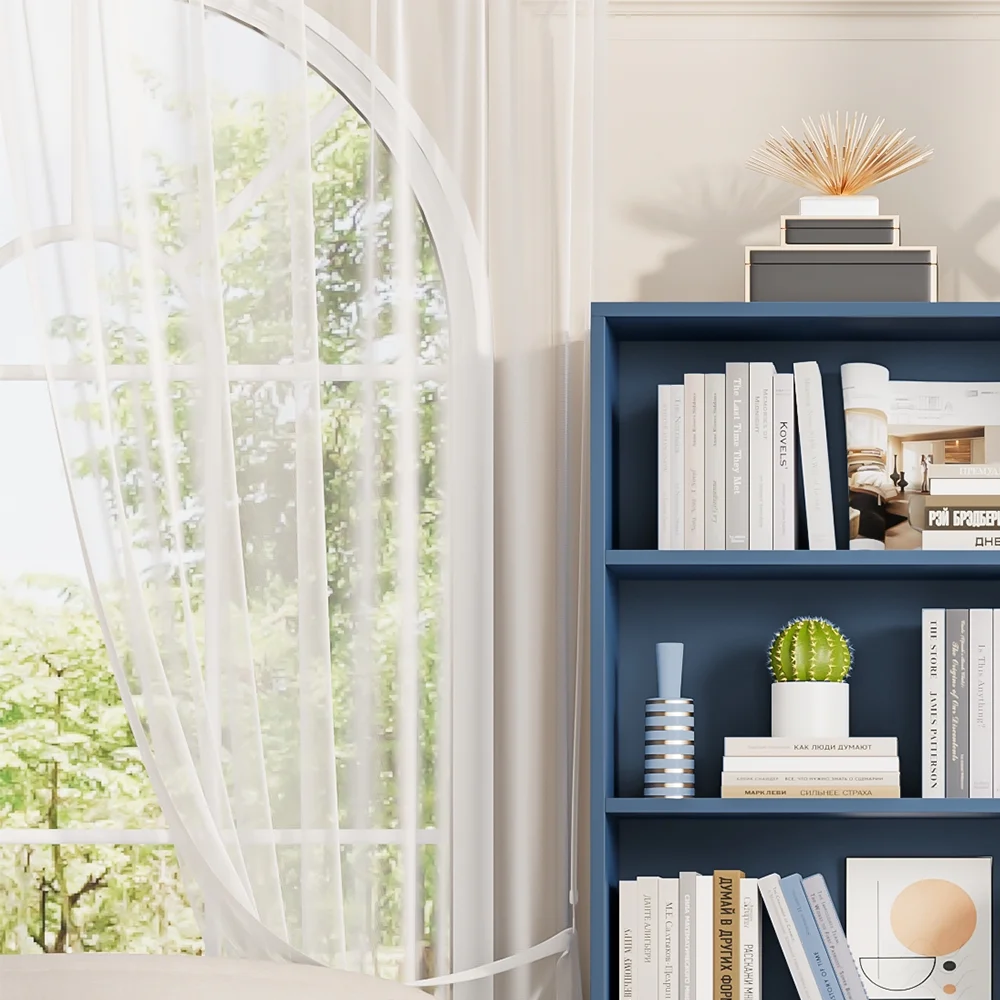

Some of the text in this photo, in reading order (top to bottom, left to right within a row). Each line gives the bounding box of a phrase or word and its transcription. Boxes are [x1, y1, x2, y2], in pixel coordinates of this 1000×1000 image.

[732, 378, 742, 495] The Last Time They Met
[928, 508, 950, 527] РЭЙ
[979, 644, 986, 653] Is
[929, 619, 938, 789] THE STORE JAMES PATTERSON
[976, 680, 986, 728] Anything?
[811, 744, 837, 752] ЛЮДИ
[837, 744, 873, 752] ДУМАЮТ
[643, 894, 651, 921] ДАНТЕ
[719, 877, 735, 915] ДУМАЙ
[719, 929, 732, 971] ДРУГИХ
[743, 944, 754, 985] РАССКАЖИ
[813, 951, 823, 967] TIME
[821, 968, 828, 977] OF
